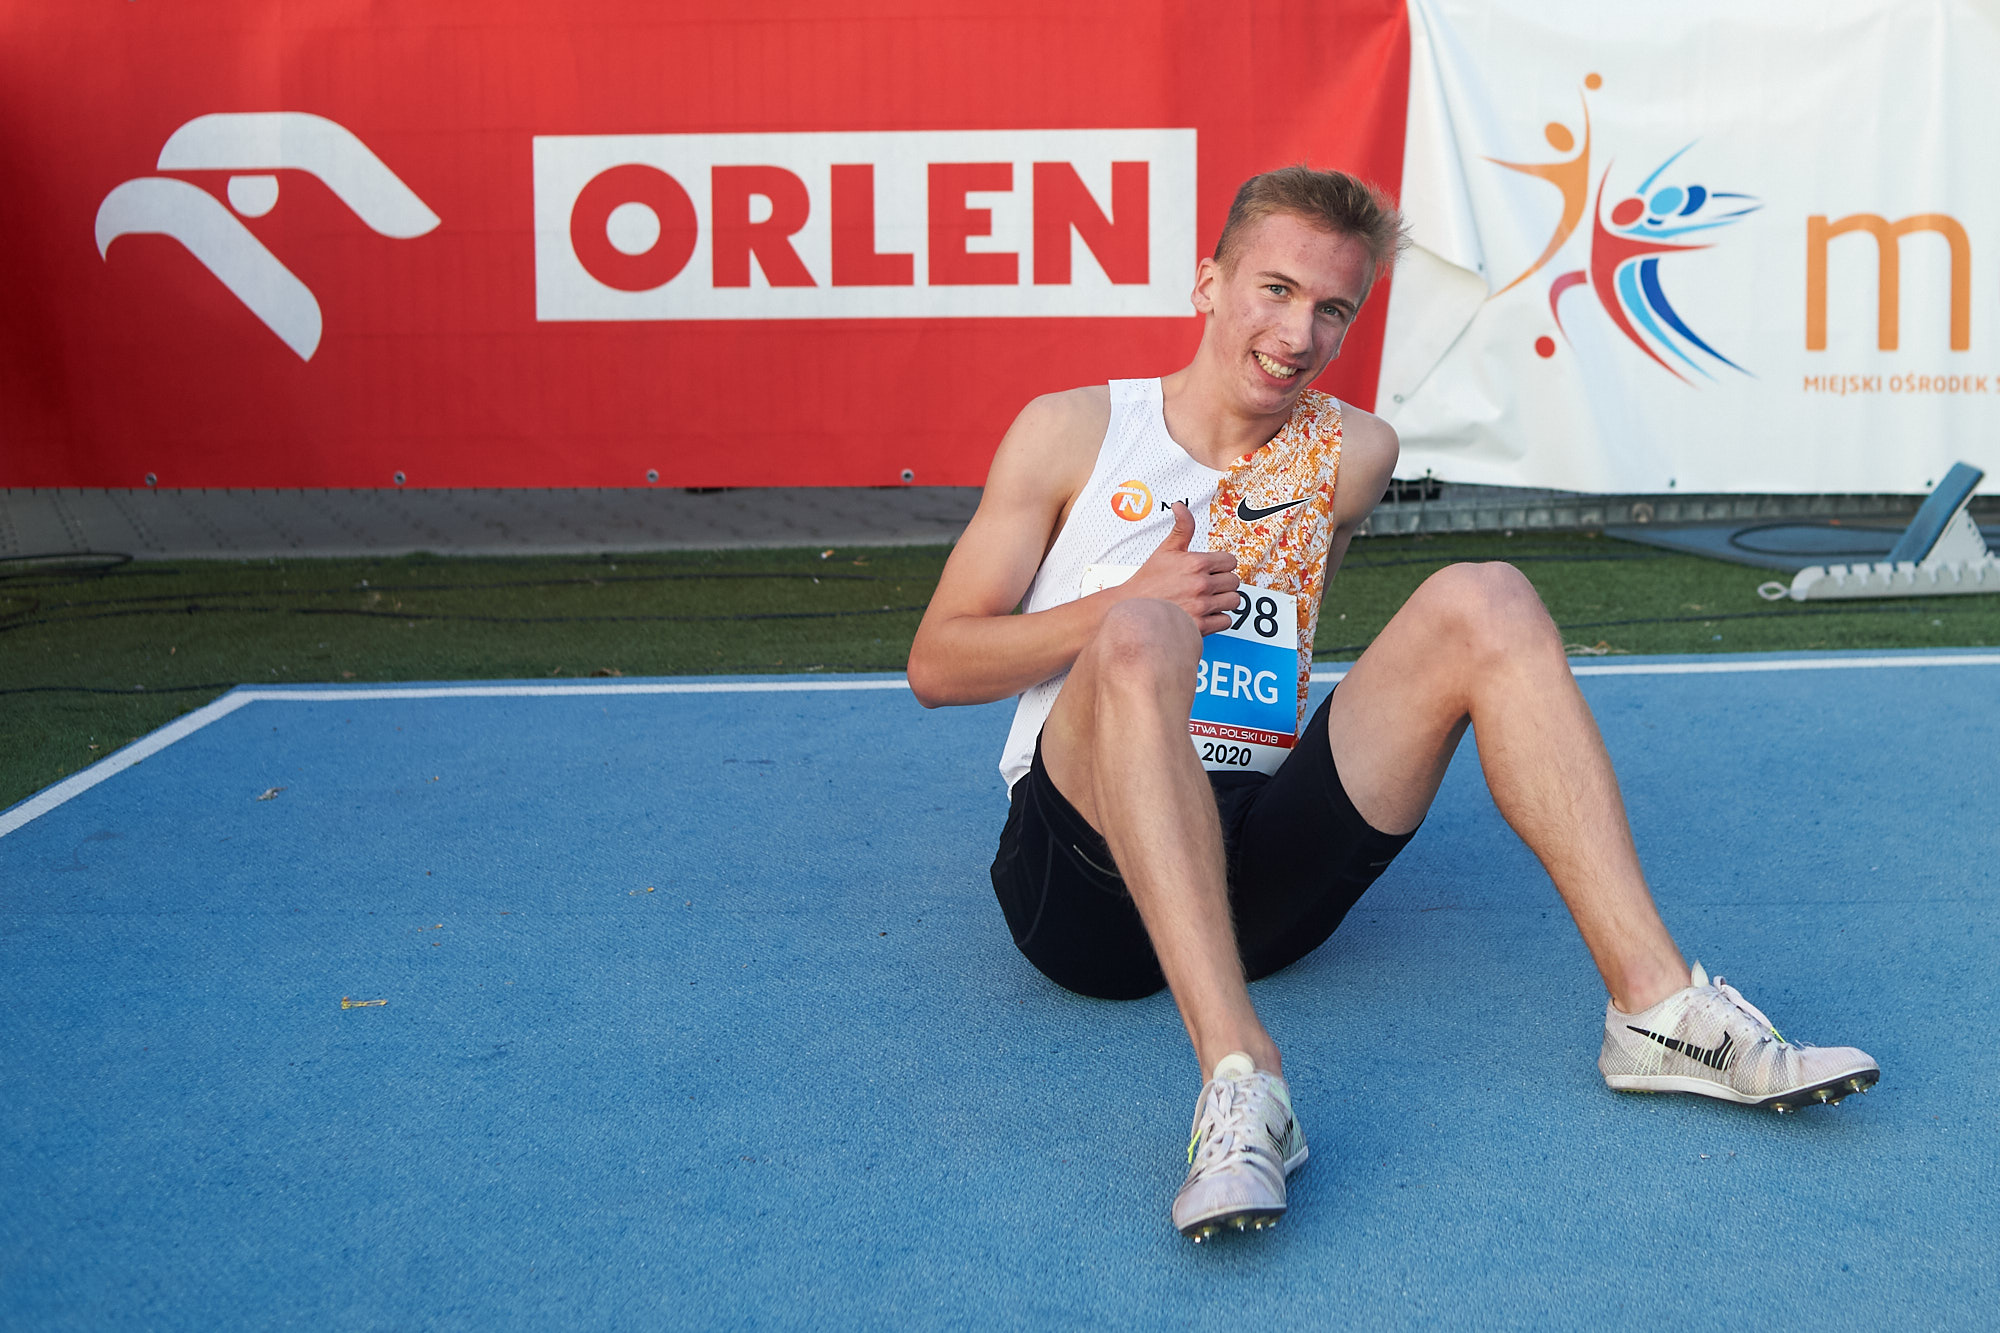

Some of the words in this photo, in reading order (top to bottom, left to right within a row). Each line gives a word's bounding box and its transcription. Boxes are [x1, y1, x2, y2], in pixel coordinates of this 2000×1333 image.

[570, 161, 1150, 293] ORLEN
[1803, 374, 1882, 396] MIEJSKI
[1889, 371, 1988, 393] OŚRODEK
[1230, 590, 1279, 638] 98
[1195, 659, 1279, 705] BERG
[1219, 727, 1258, 742] POLSKI
[1260, 733, 1279, 744] U18
[1202, 742, 1252, 767] 2020
